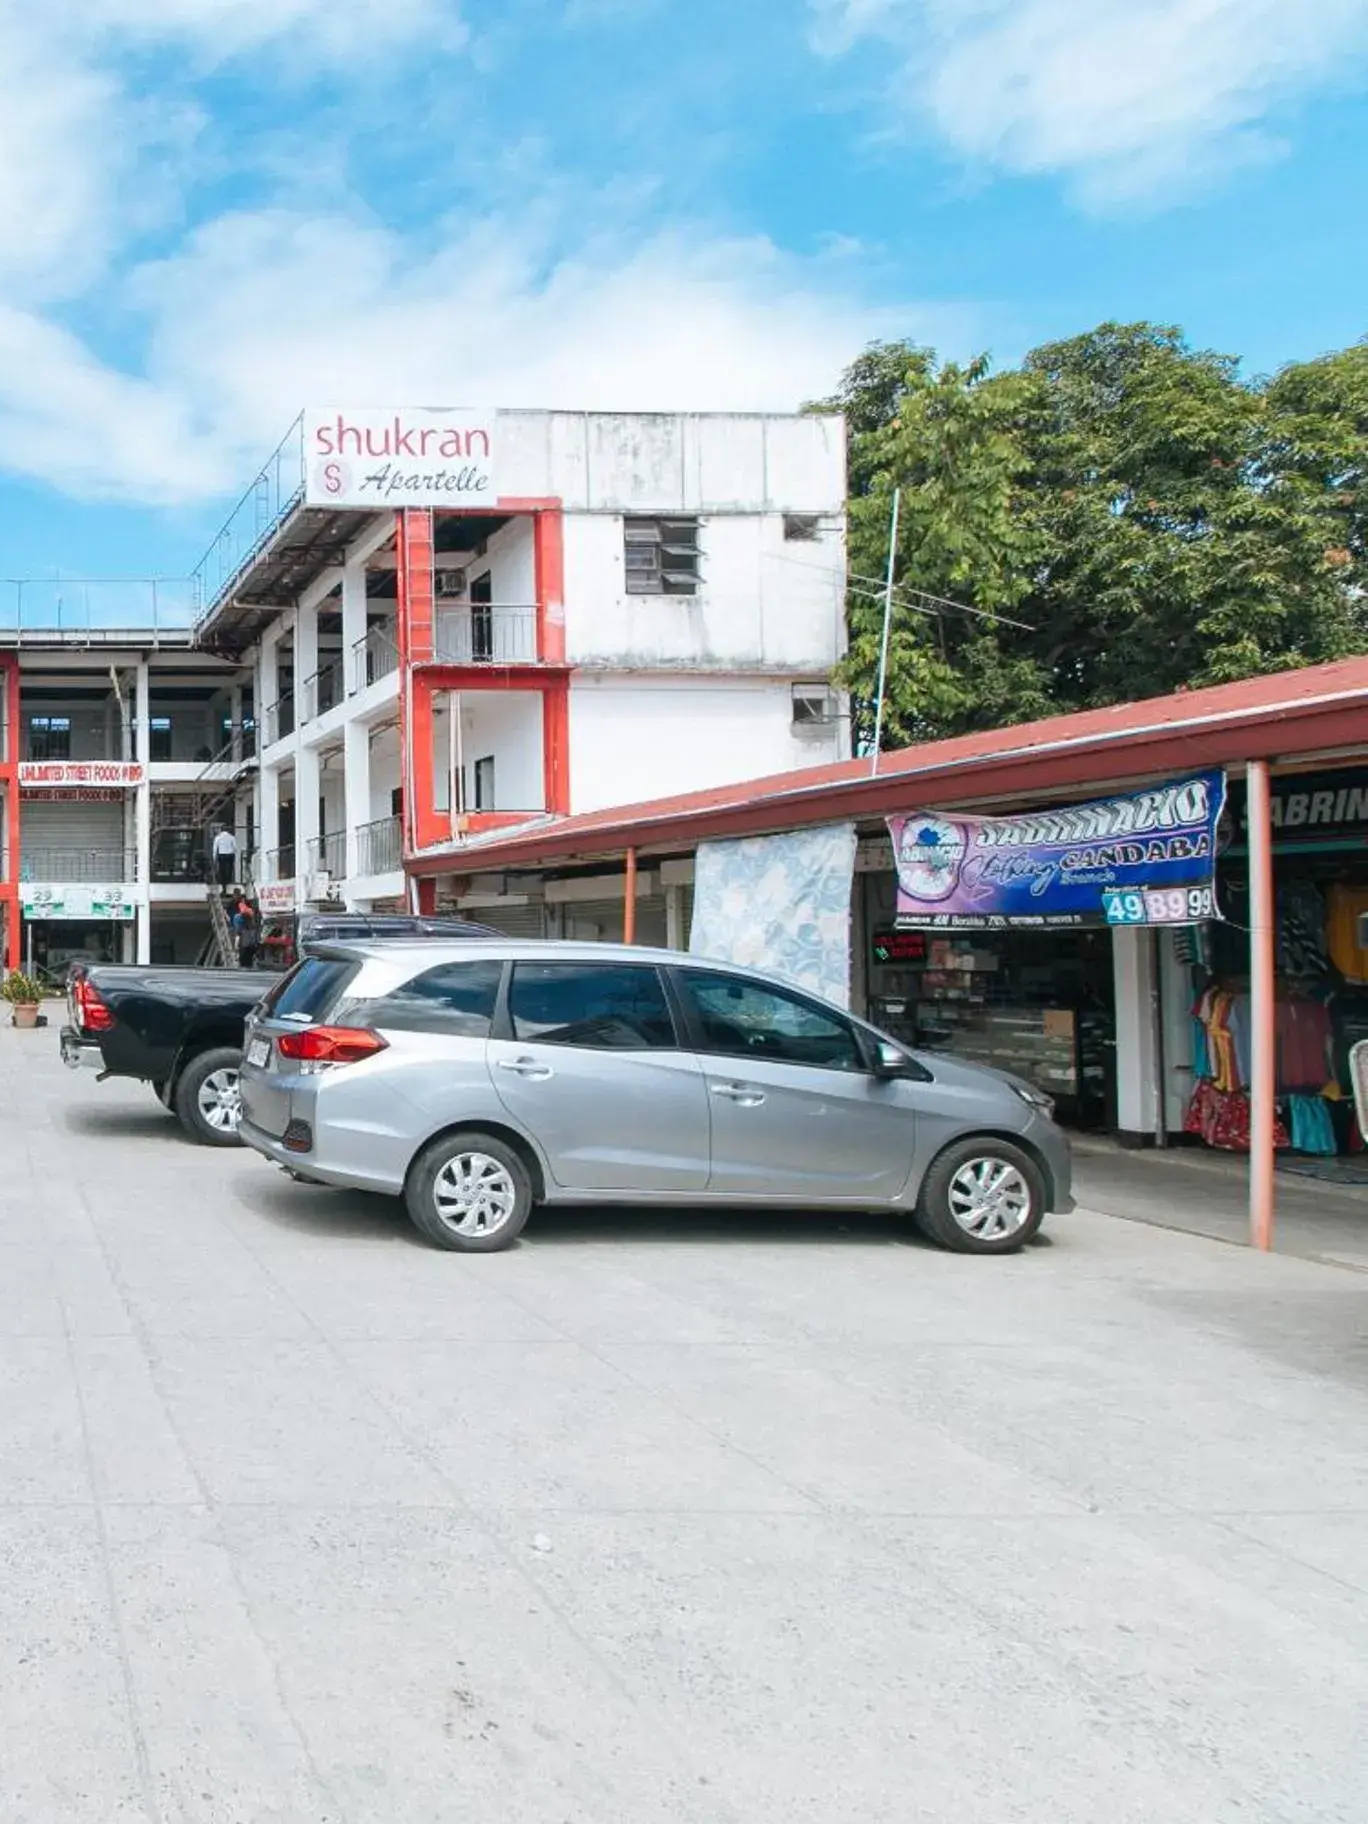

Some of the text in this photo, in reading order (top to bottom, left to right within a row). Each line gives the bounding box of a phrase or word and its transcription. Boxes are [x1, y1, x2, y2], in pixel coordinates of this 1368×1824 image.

[316, 414, 490, 457] shukran
[359, 462, 489, 498] Apartelle
[22, 765, 64, 781] UNLIMITED
[66, 765, 92, 781] STREET
[94, 764, 121, 781] FOODS
[1240, 787, 1368, 829] ABRIN
[1060, 834, 1210, 870] CANDABA
[1107, 894, 1144, 920] 49
[1149, 891, 1184, 919] 89
[1188, 889, 1212, 916] 99
